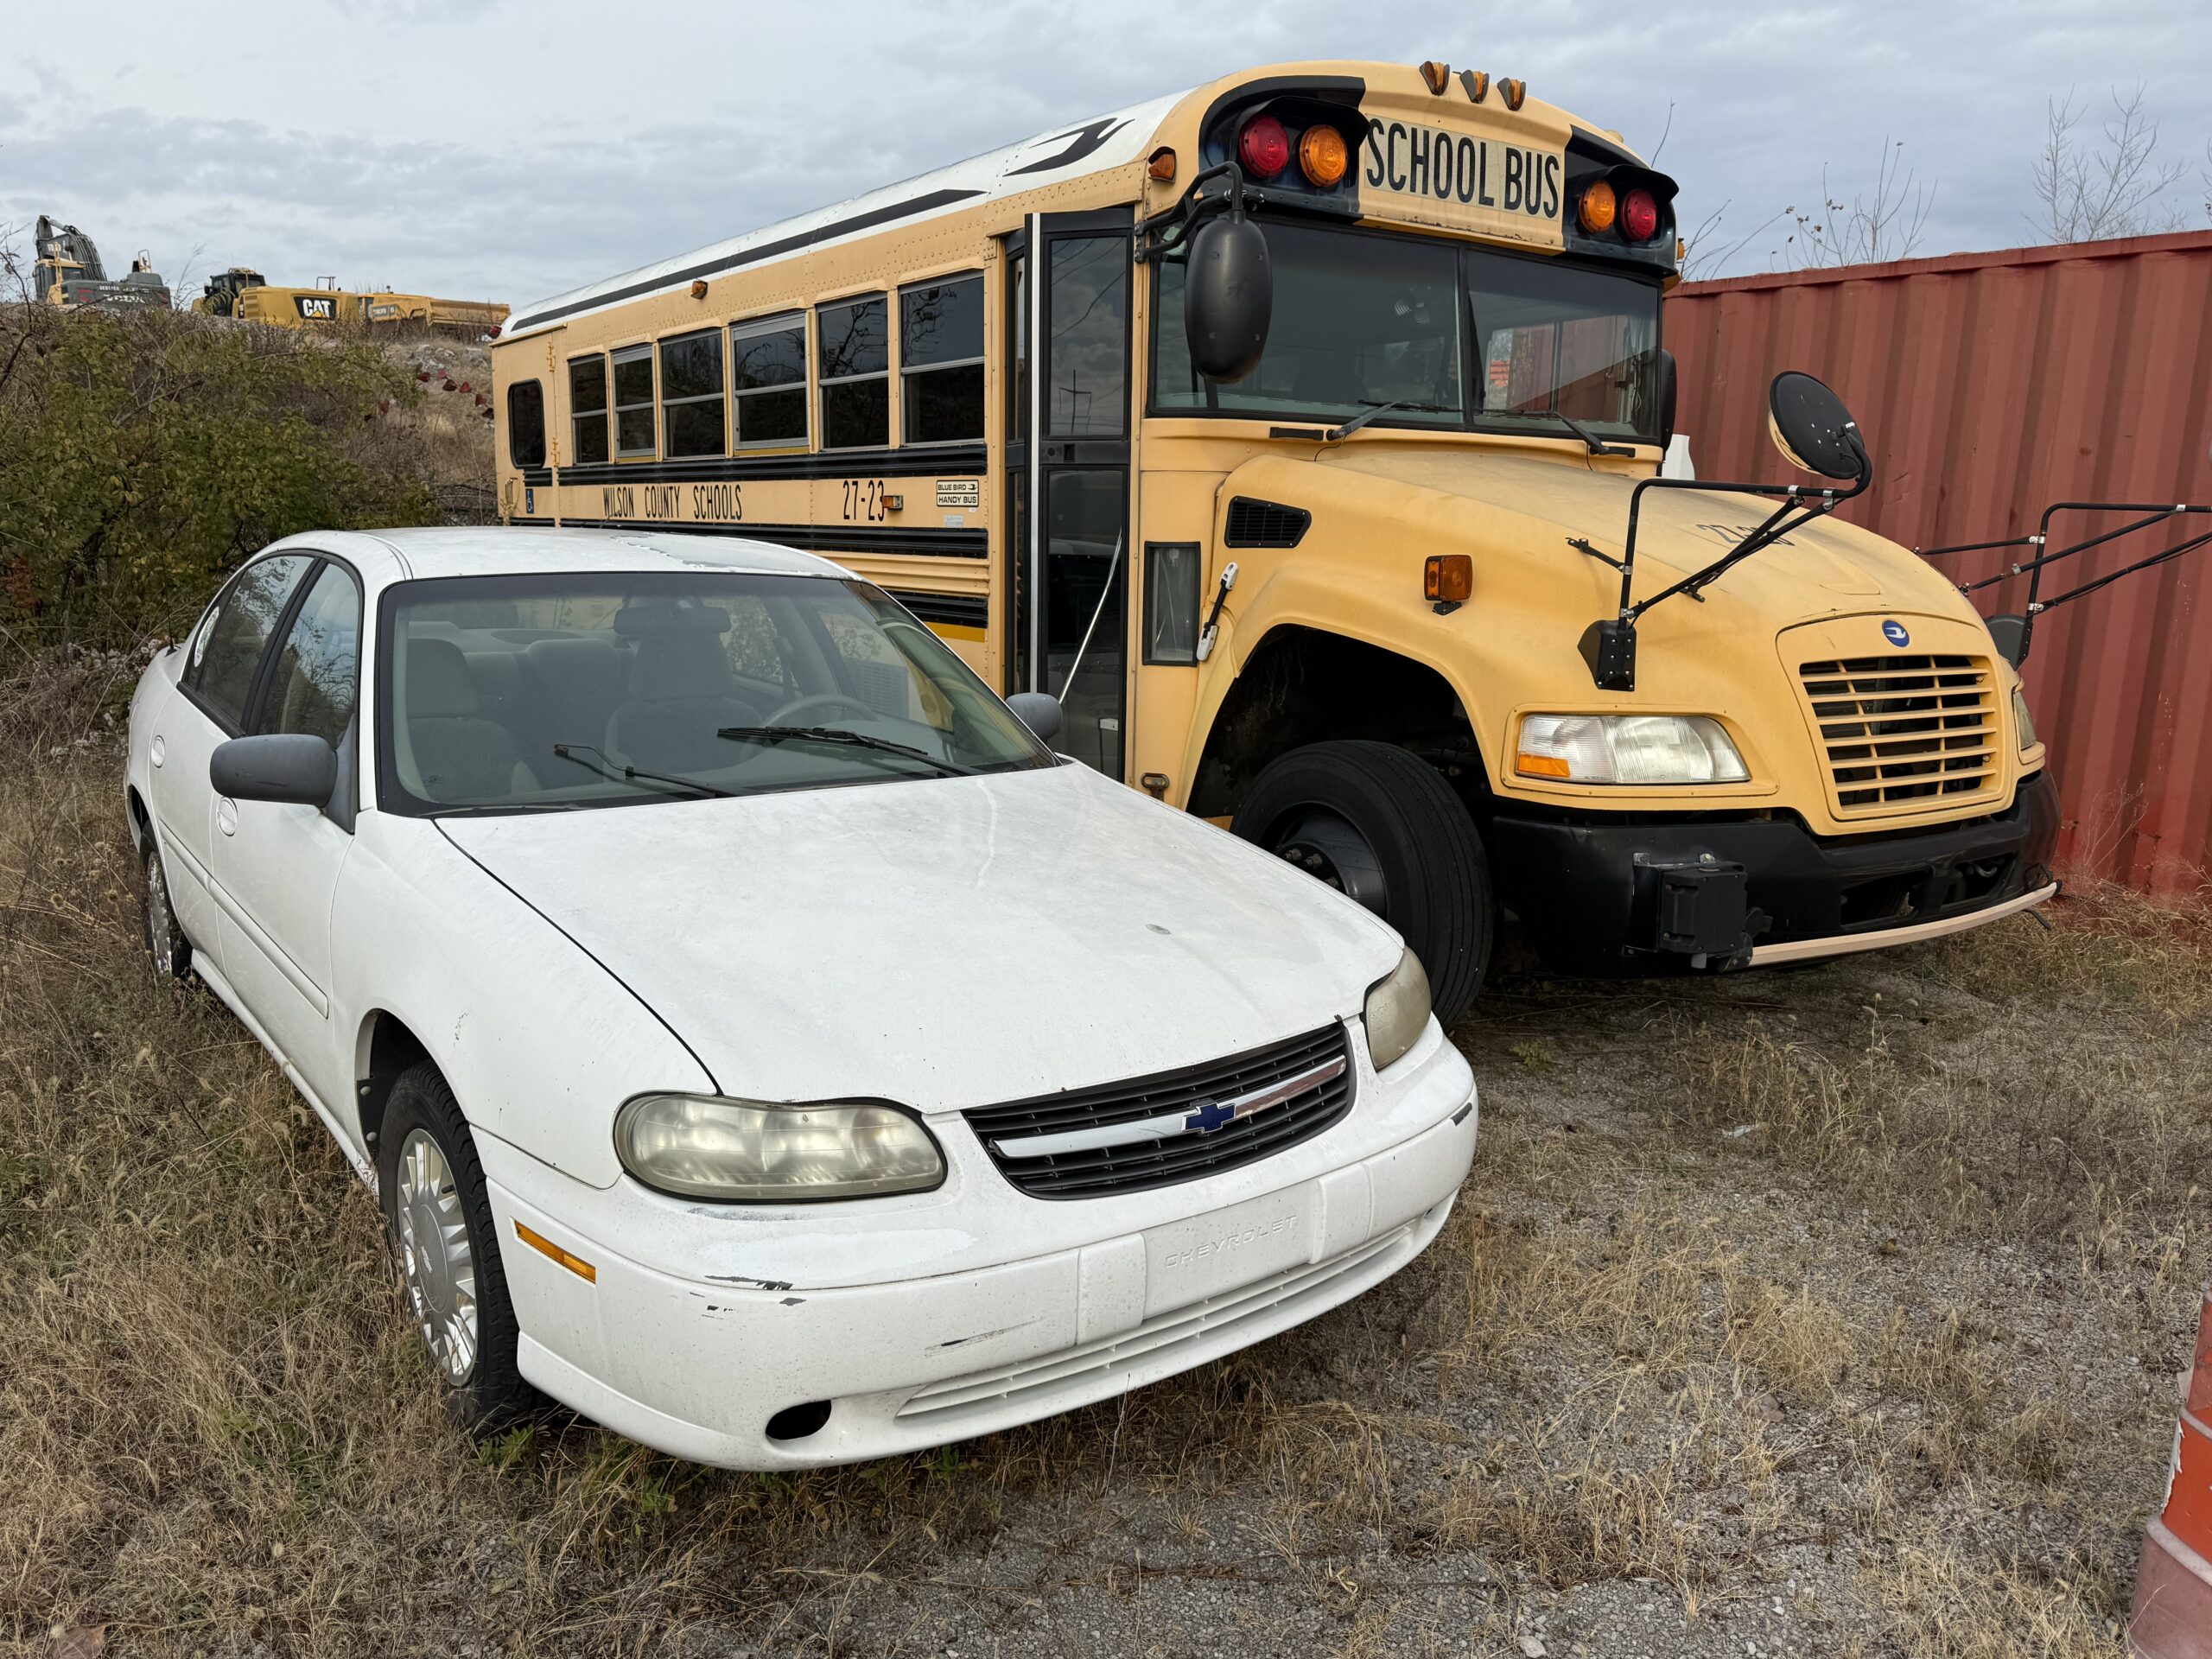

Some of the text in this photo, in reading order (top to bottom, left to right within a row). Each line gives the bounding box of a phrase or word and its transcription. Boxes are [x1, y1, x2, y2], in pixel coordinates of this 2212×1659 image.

[1366, 118, 1560, 219] SCHOOL BUS
[303, 299, 330, 318] CAT
[603, 484, 742, 520] WILSON COUNTY SCHOOLS
[842, 480, 884, 522] 27-23
[1165, 1214, 1297, 1268] CHEVROLET
